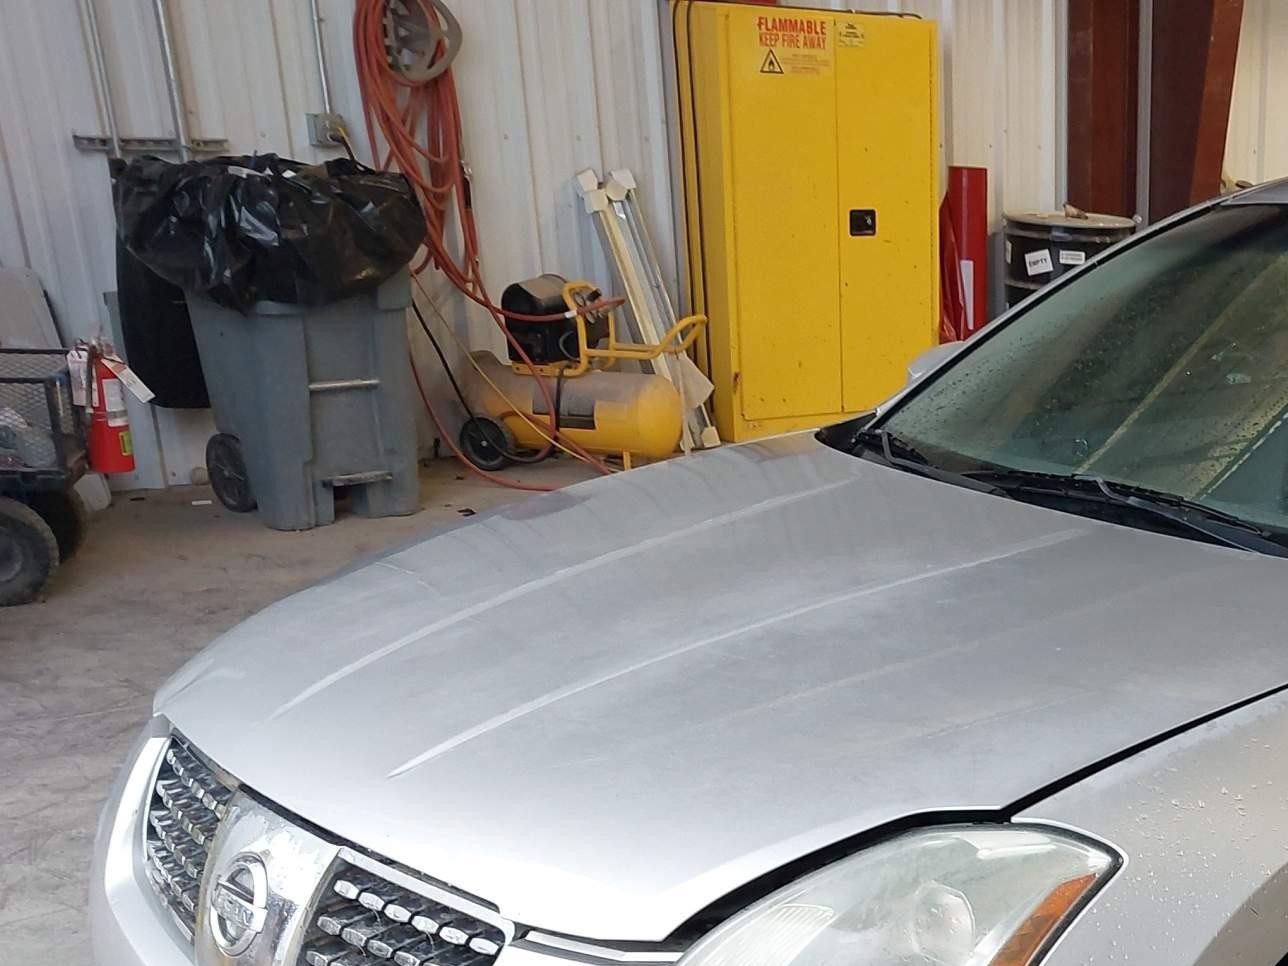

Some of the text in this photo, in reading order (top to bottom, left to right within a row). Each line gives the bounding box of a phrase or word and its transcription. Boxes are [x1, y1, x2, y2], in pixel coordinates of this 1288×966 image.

[757, 16, 827, 36] FLAMMABLE
[759, 32, 779, 47] KEEP
[782, 33, 801, 49] FIRE
[803, 35, 827, 49] AWAY
